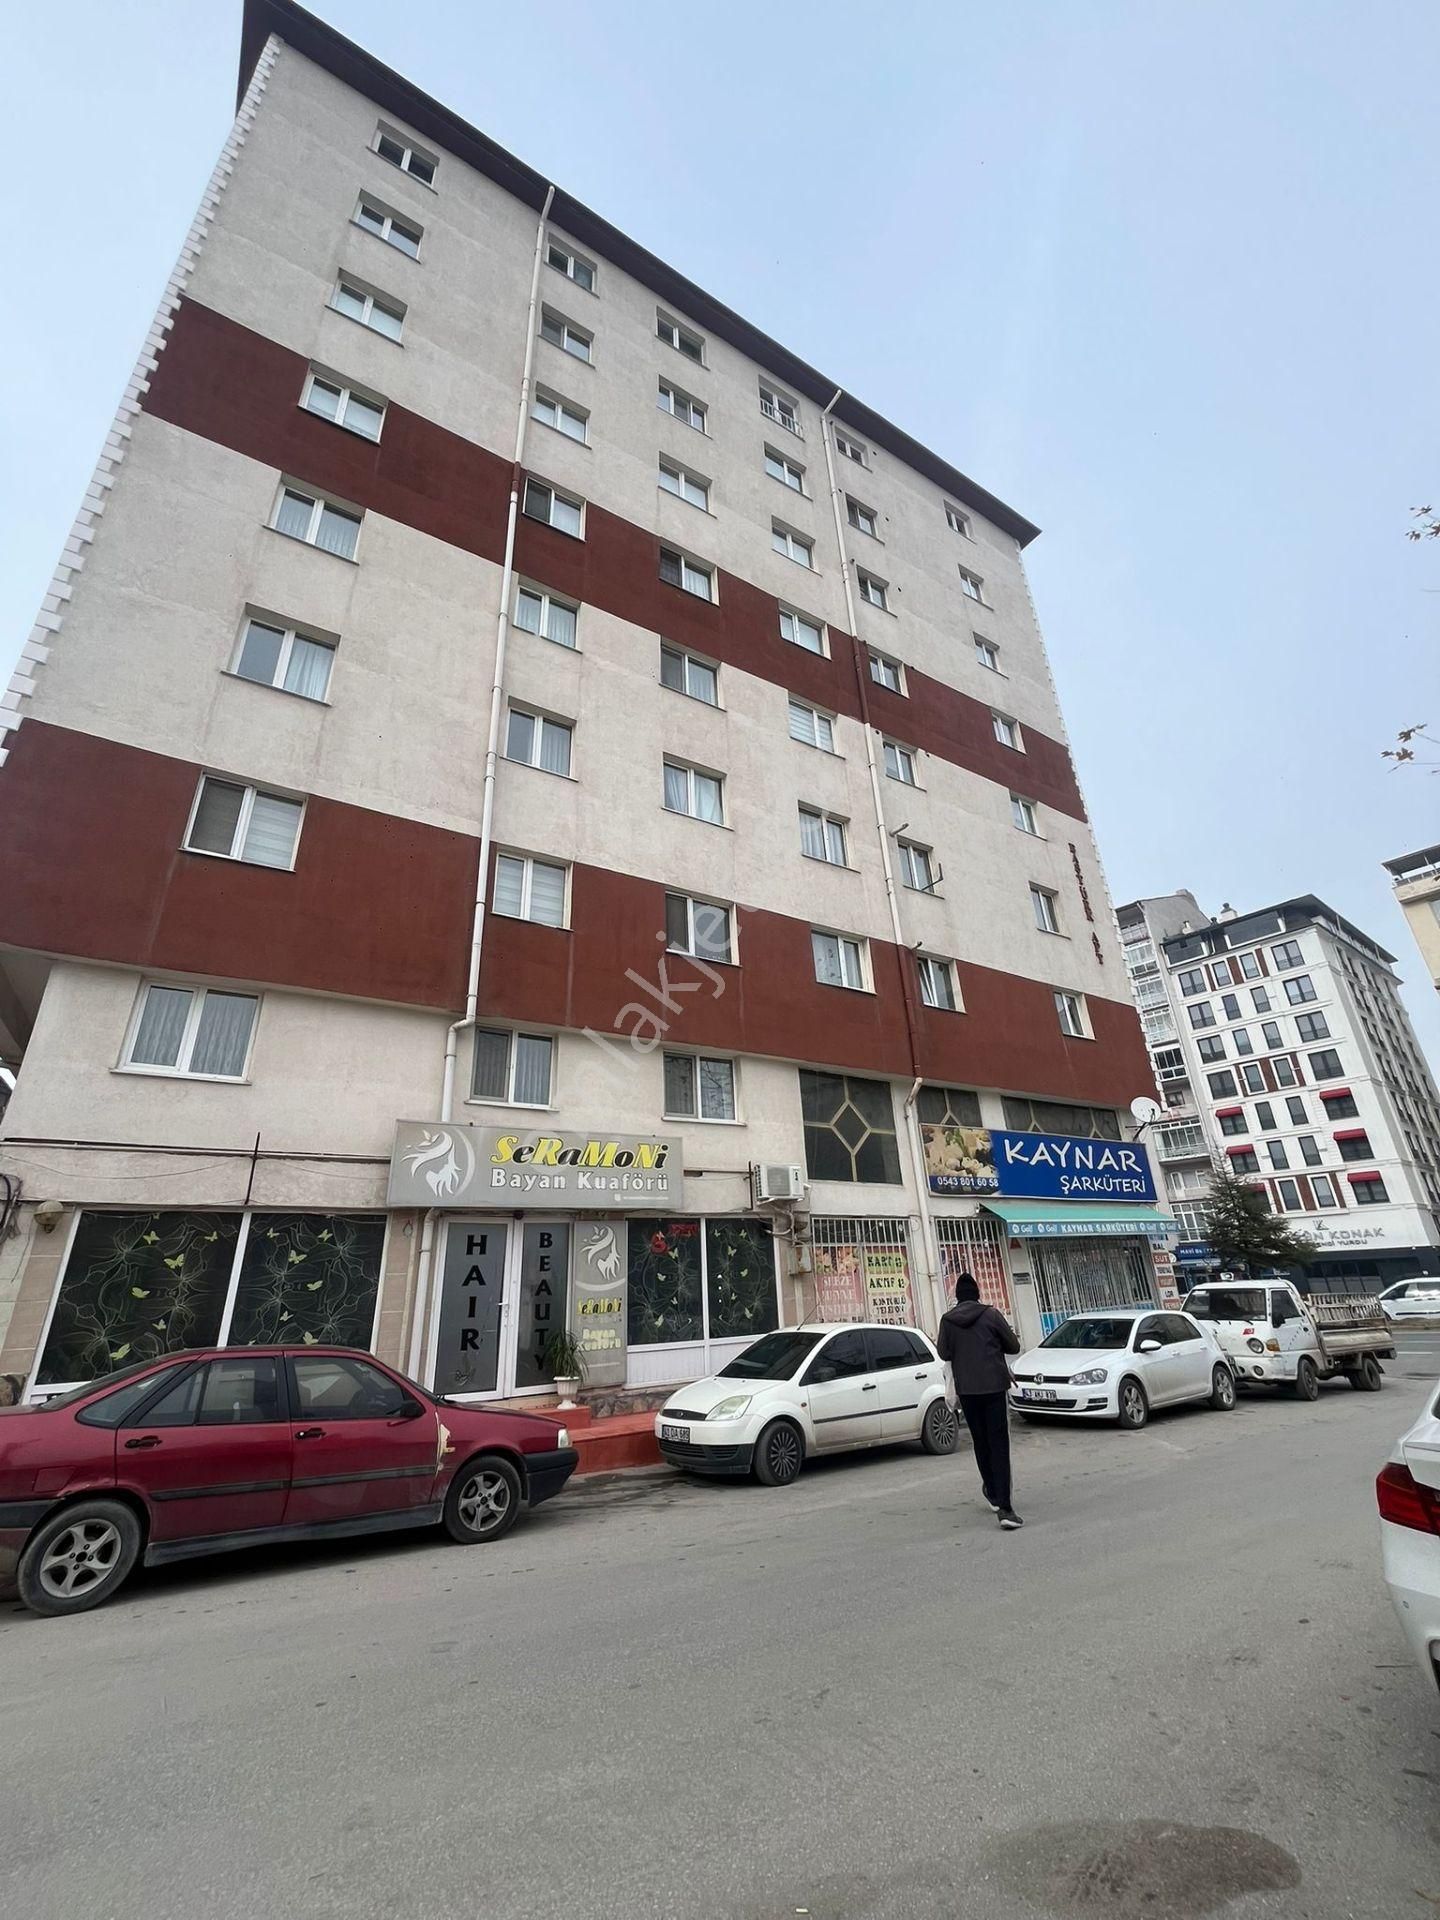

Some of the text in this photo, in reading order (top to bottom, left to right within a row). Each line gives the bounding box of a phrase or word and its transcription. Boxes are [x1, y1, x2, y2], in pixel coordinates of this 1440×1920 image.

[490, 1135, 669, 1168] SeRaMoNi
[1003, 1139, 1143, 1173] KAYNAR
[490, 1168, 668, 1191] Bayan Kuaförü
[937, 1176, 958, 1186] 0543
[959, 1177, 975, 1186] 801
[1060, 1175, 1146, 1194] ŞARKÜTERİ
[1061, 1224, 1093, 1234] KAYNAR
[1329, 1227, 1385, 1240] KONAK
[460, 1234, 488, 1351] HAIR
[534, 1232, 553, 1371] BEAUTY
